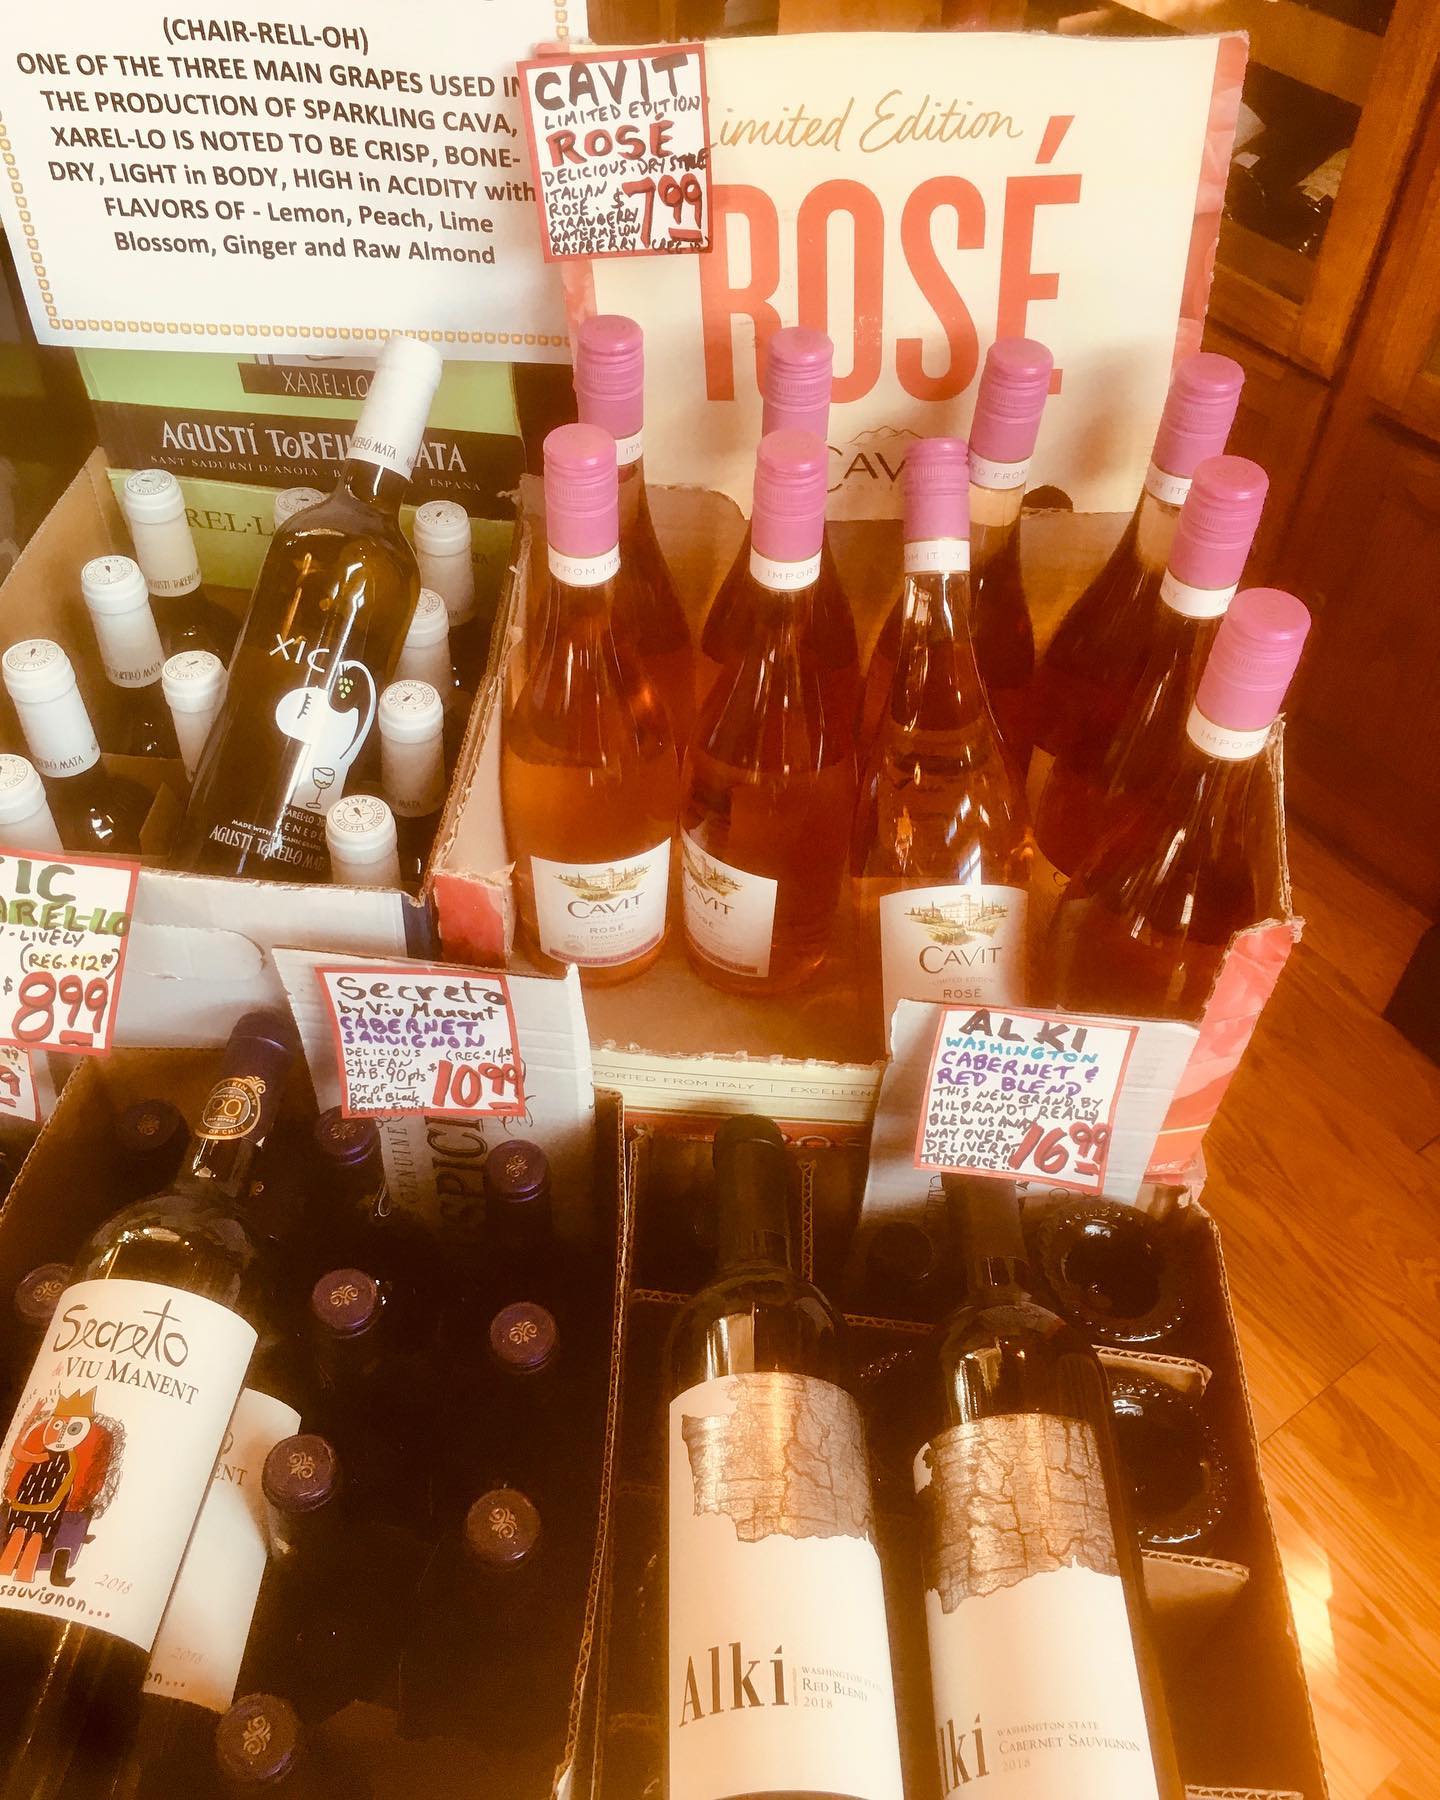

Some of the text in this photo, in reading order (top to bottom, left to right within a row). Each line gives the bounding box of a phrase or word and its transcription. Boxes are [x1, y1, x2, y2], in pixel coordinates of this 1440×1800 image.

[163, 17, 368, 55] (CHAIR-RELL-OH)
[17, 52, 70, 74] ONE
[76, 54, 108, 76] OF
[114, 55, 163, 77] THE
[167, 56, 248, 80] THREE
[254, 59, 322, 84] MAIN
[330, 64, 422, 94] GRAPES
[430, 74, 494, 97] USED
[535, 52, 688, 111] CAVIT
[40, 90, 518, 138] THE PRODUCTION OF SPARKLING CAVA,
[544, 96, 700, 130] LIMITED EDITION
[709, 88, 1023, 152] imited Edition
[51, 126, 520, 168] XAREL-LO IS NOTED TO BE CRISP, BONE-
[546, 112, 674, 167] ROSÉ
[638, 158, 666, 176] DRY
[48, 161, 536, 202] DRY, LIGHT in BODY, HIGH in ACIDITY with
[545, 182, 607, 204] ITALIAN
[104, 197, 209, 220] FLAVORS
[214, 200, 246, 220] OF
[267, 202, 352, 228] Lemon,
[358, 205, 433, 232] Peach,
[440, 210, 494, 233] Lime
[114, 232, 496, 264] Blossom, Ginger and Raw Almond
[552, 238, 636, 256] RASPBERRY
[699, 115, 1082, 403] ROSÉ
[162, 420, 259, 456] AGUSTÍ
[416, 440, 467, 472] ATA
[372, 442, 396, 460] MATA
[150, 455, 186, 467] SANT
[186, 507, 278, 537] REL·L
[270, 634, 330, 672] XIC
[60, 754, 84, 771] MATA
[209, 824, 255, 851] AGUSTÍ
[232, 820, 272, 836] MADE WITH
[0, 857, 76, 902] IC
[568, 891, 646, 919] CAVIT
[919, 946, 1002, 974] CAVIT
[336, 976, 506, 1005] Secreto
[338, 1000, 364, 1018] by
[411, 1002, 499, 1021] Manent
[340, 1016, 479, 1036] CABERNET
[343, 1031, 485, 1049] SAUVIGNON
[959, 1008, 1088, 1053] ALKI
[346, 1048, 421, 1057] DELICIOUS
[346, 1058, 412, 1068] CHILEAN
[945, 1036, 1099, 1064] WASHINGTON
[942, 1050, 1074, 1080] CABERNET
[350, 1082, 388, 1094] LOT OF
[594, 1071, 873, 1098] PORTED FROM ITALY EXCELLEN
[936, 1067, 1082, 1096] RED BLEND
[350, 1092, 374, 1104] Red
[931, 1099, 1099, 1124] MILBRANDT REALLY
[933, 1086, 969, 1098] THIS
[977, 1088, 1014, 1101] NEW
[1080, 1097, 1103, 1111] BY
[929, 1113, 974, 1126] BLEW
[978, 1116, 994, 1128] US
[926, 1128, 1014, 1144] WAY OVER-
[926, 1140, 999, 1158] DELIVER
[920, 1154, 956, 1166] THIS
[53, 1298, 188, 1368] Secreto
[679, 1641, 790, 1728] Alki
[936, 1713, 990, 1800] lki
